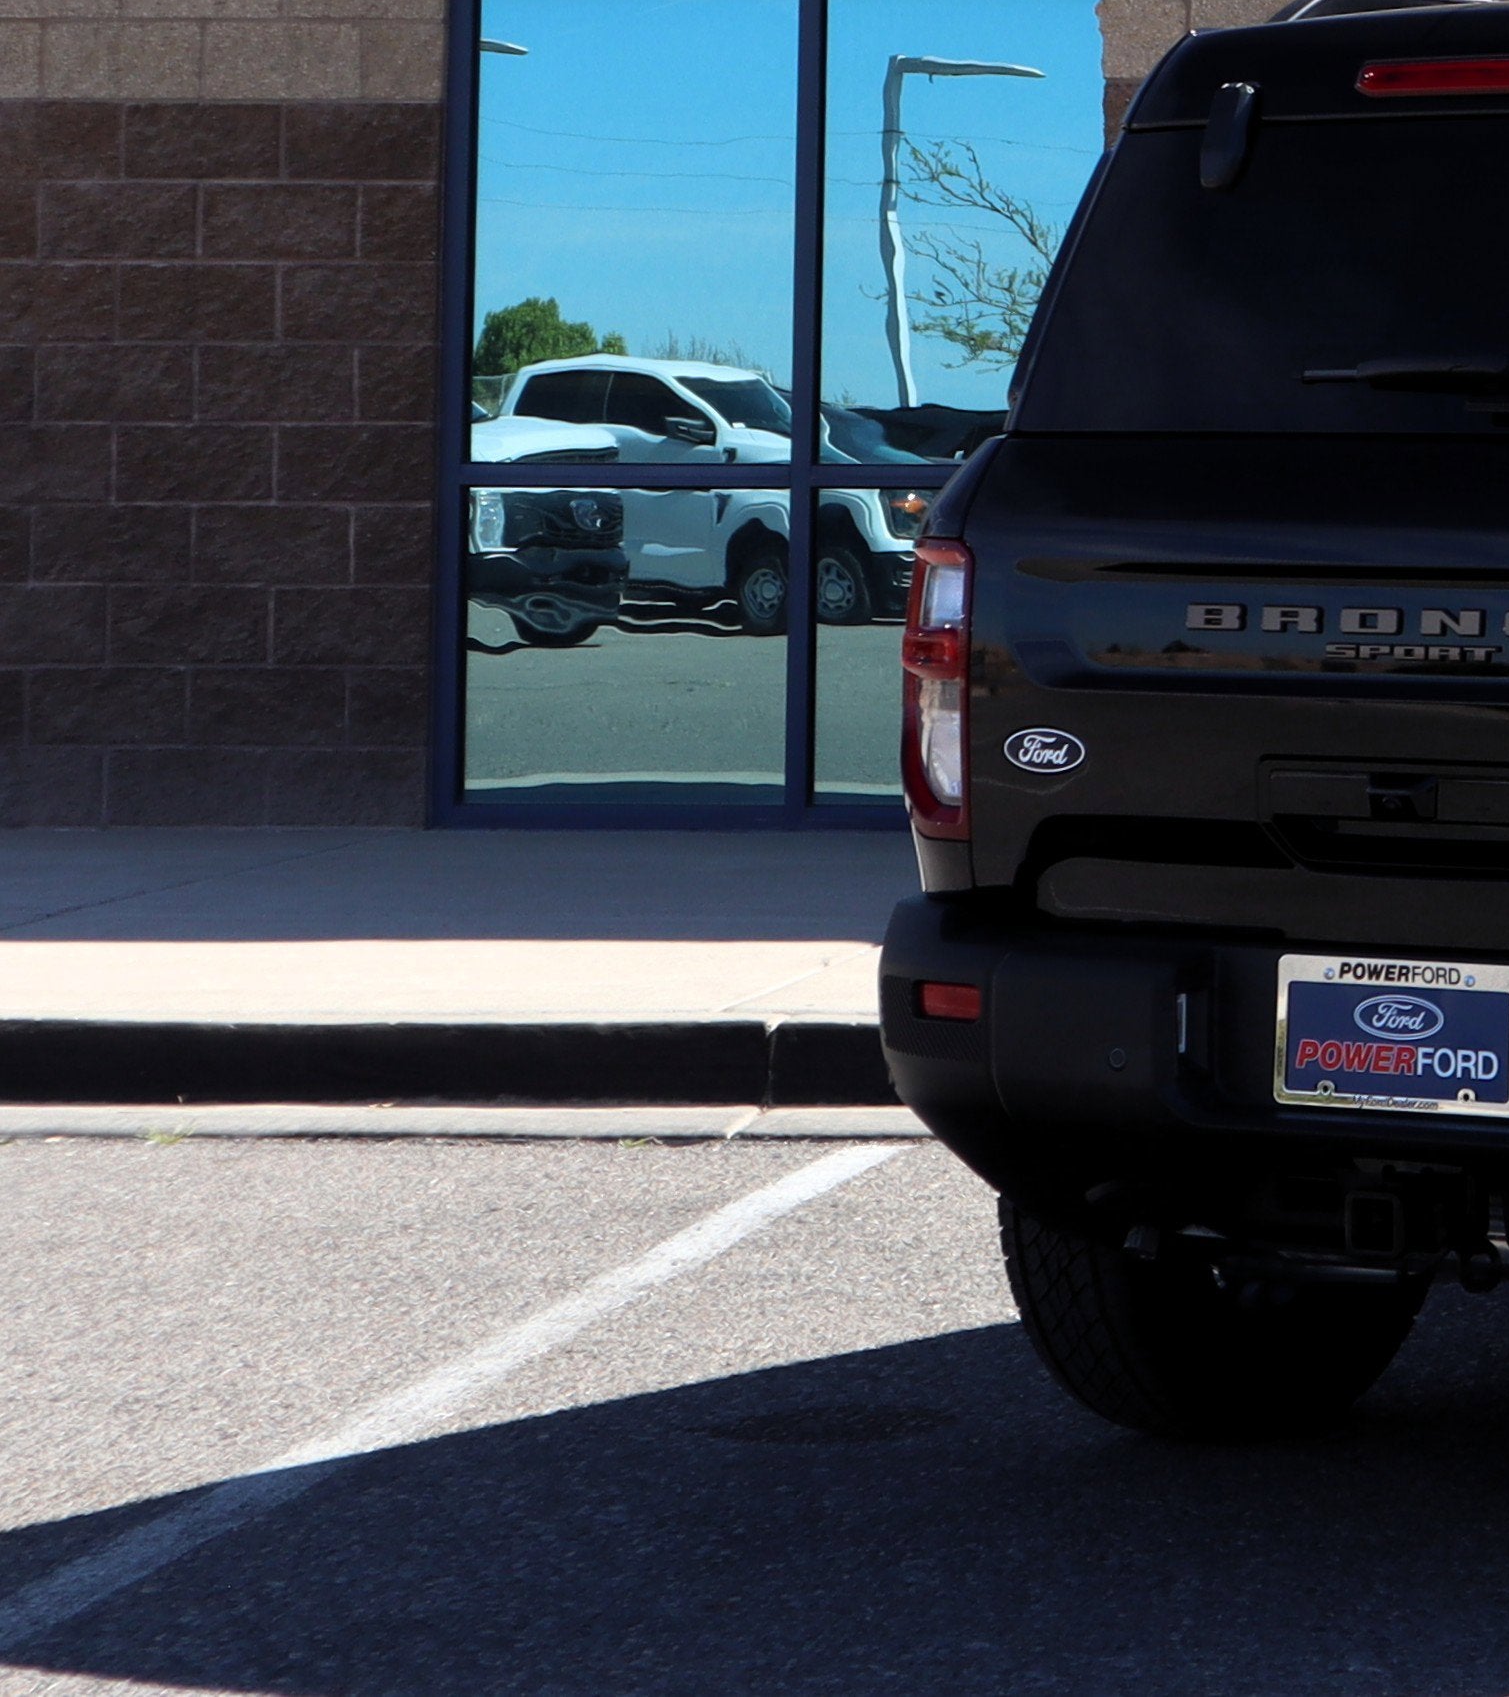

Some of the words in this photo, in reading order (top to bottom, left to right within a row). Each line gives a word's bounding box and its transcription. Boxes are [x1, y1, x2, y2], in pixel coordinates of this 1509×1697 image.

[1324, 643, 1502, 662] SPORT
[1018, 735, 1069, 764] Ford
[1339, 962, 1461, 985] POWERFORD
[1371, 1002, 1425, 1030] Ford
[1296, 1039, 1498, 1080] POWERFORD
